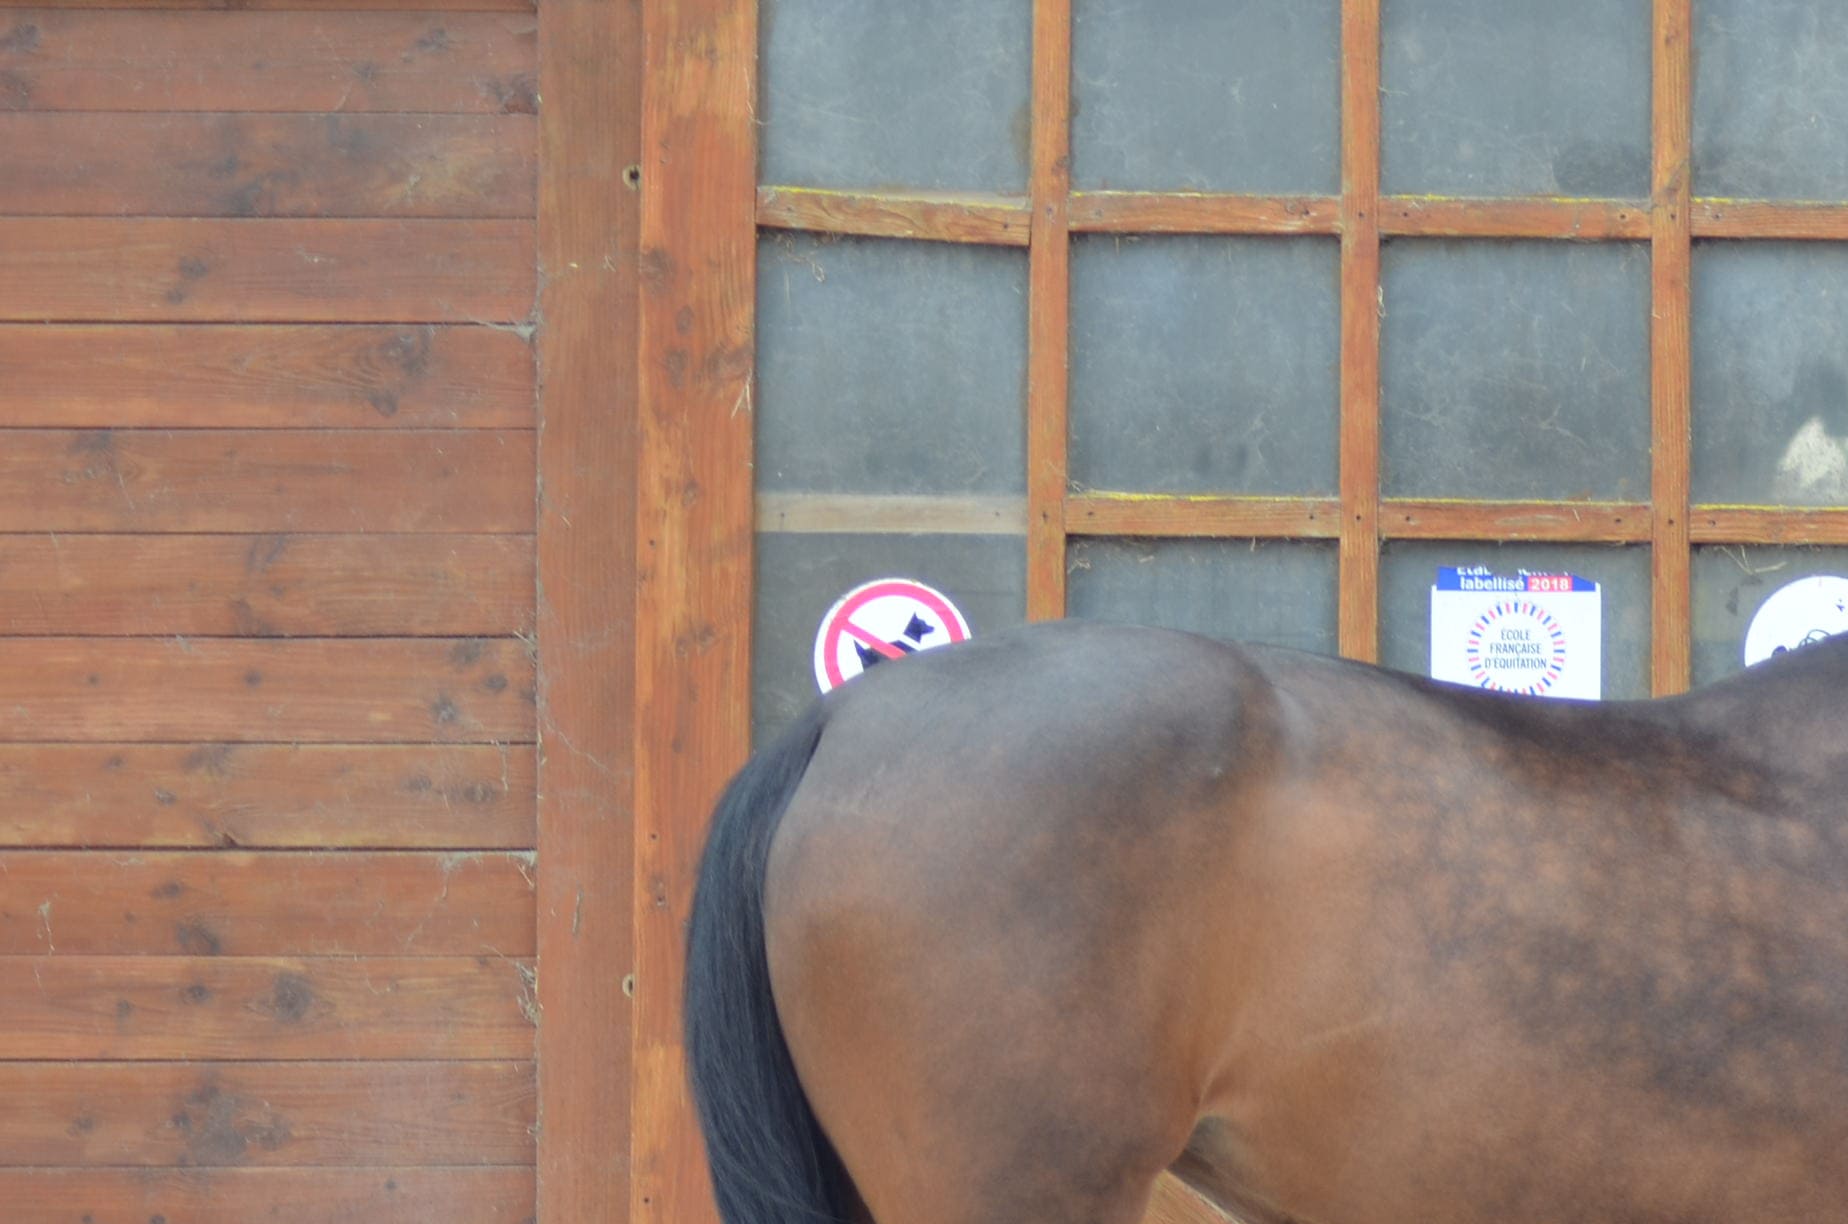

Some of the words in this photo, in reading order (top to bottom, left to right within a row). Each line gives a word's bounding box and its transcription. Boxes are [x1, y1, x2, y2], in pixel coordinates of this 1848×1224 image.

[1460, 575, 1525, 590] labellisé
[1531, 578, 1569, 590] 2018
[1490, 643, 1542, 656] FRANÇAISE
